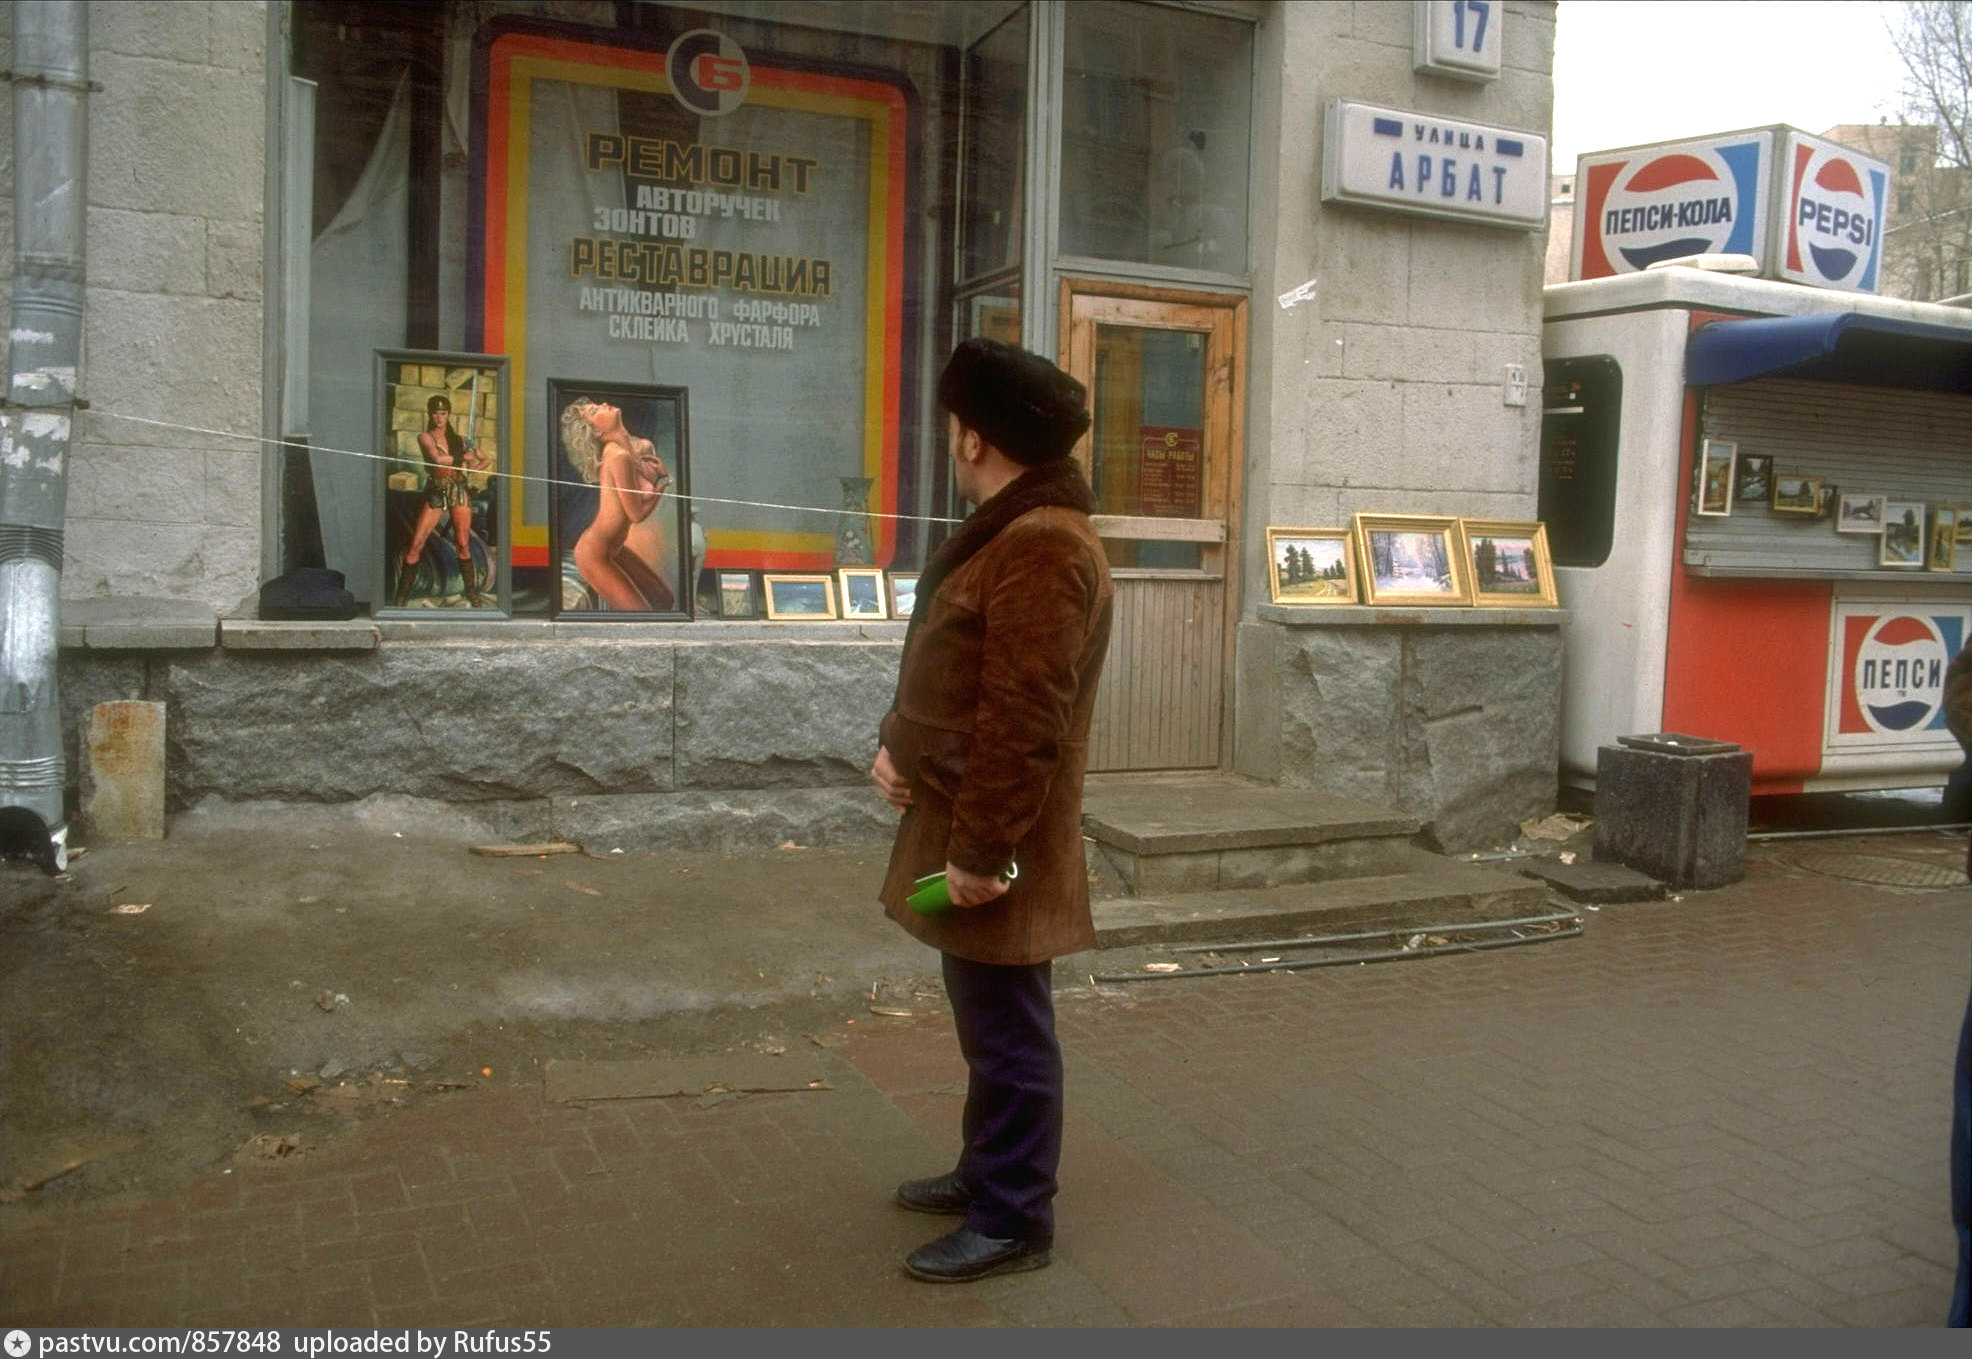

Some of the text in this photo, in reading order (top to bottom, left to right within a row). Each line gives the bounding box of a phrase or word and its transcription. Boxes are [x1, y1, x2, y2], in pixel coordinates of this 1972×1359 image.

[1454, 1, 1489, 52] 17
[1415, 124, 1484, 150] УЛИЦА
[586, 131, 818, 194] РЕМОНТ
[1389, 151, 1506, 204] АРБАТ
[637, 185, 780, 222] АВТОРУЧЕК
[1606, 197, 1732, 235] ПЕПСИ-КОЛА
[1799, 197, 1872, 247] PEPSI
[593, 208, 696, 239] ЗОНТОВ
[569, 235, 832, 297] РЕСТАВРАЦИЯ
[580, 287, 820, 326] АНТИКВАРНОГО ФАРФОРА
[609, 315, 793, 348] СКЛЕЙКА ХРУСТАЛЯ
[1864, 658, 1940, 689] ПЕПСИ
